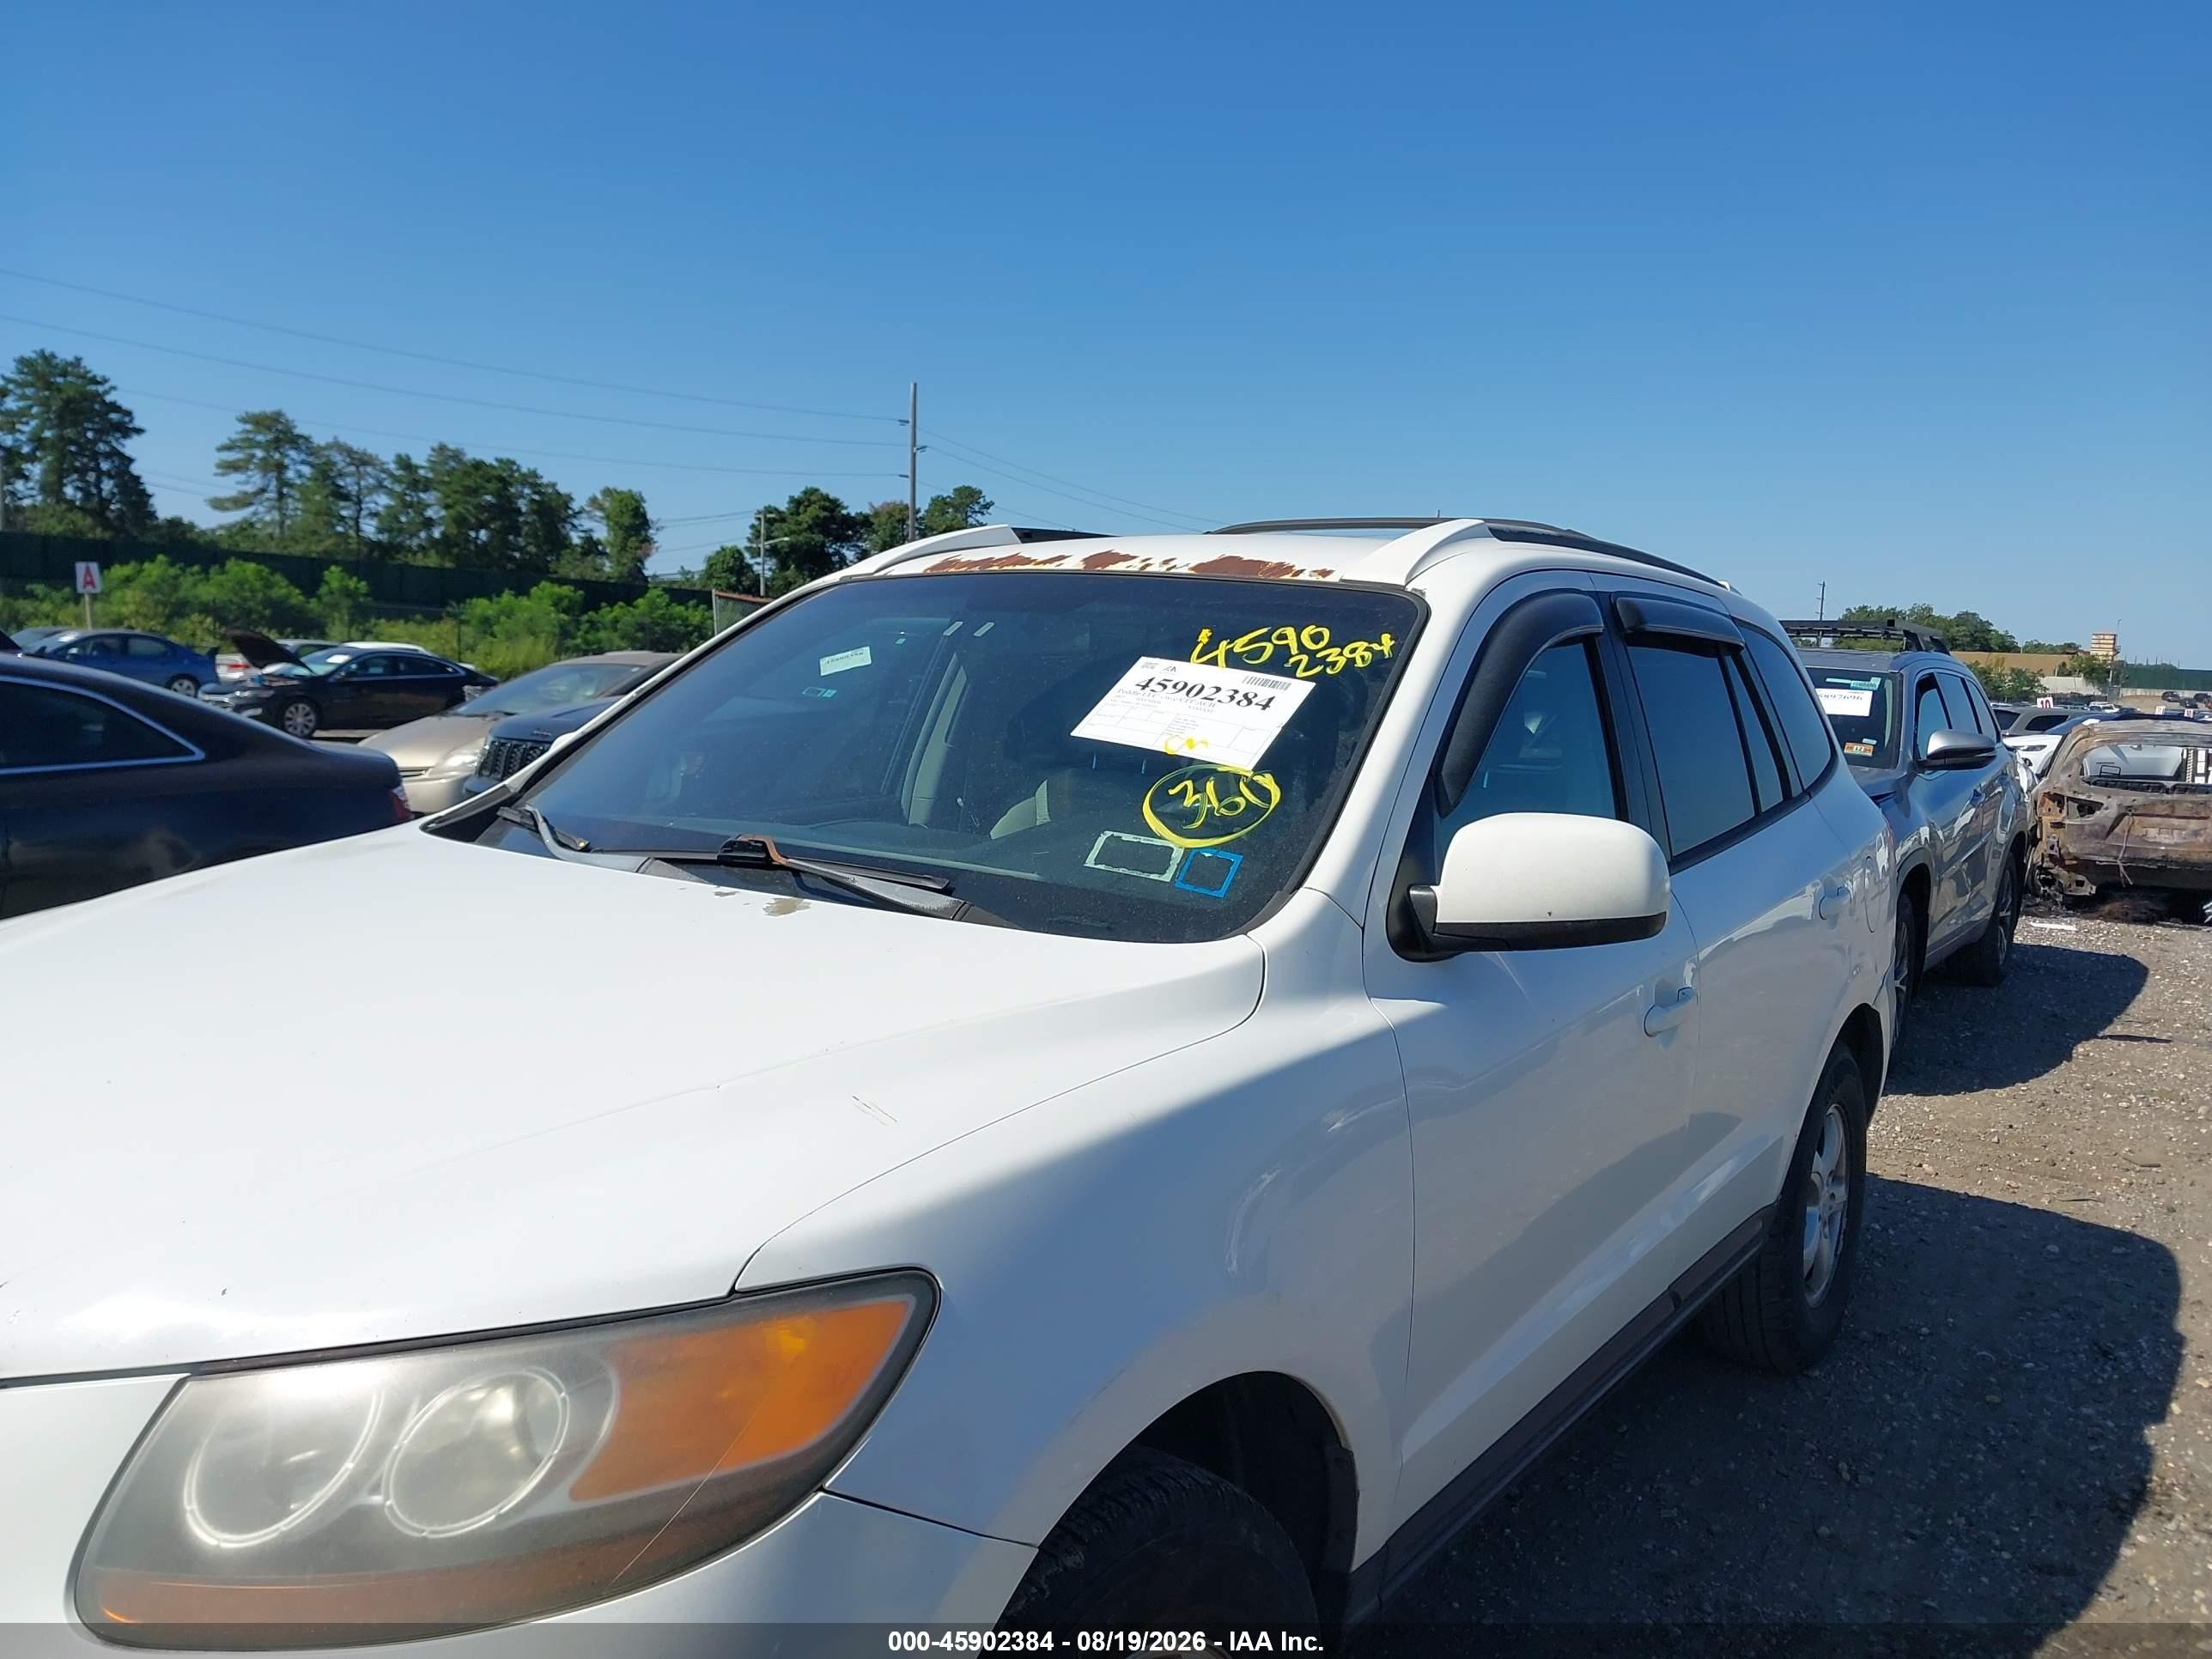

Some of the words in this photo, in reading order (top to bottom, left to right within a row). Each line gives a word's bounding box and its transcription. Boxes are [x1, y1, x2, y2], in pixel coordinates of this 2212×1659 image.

[82, 565, 96, 590] A
[1190, 624, 1330, 668] 4590
[1284, 634, 1395, 678] 2384
[1135, 676, 1276, 712] 45902384
